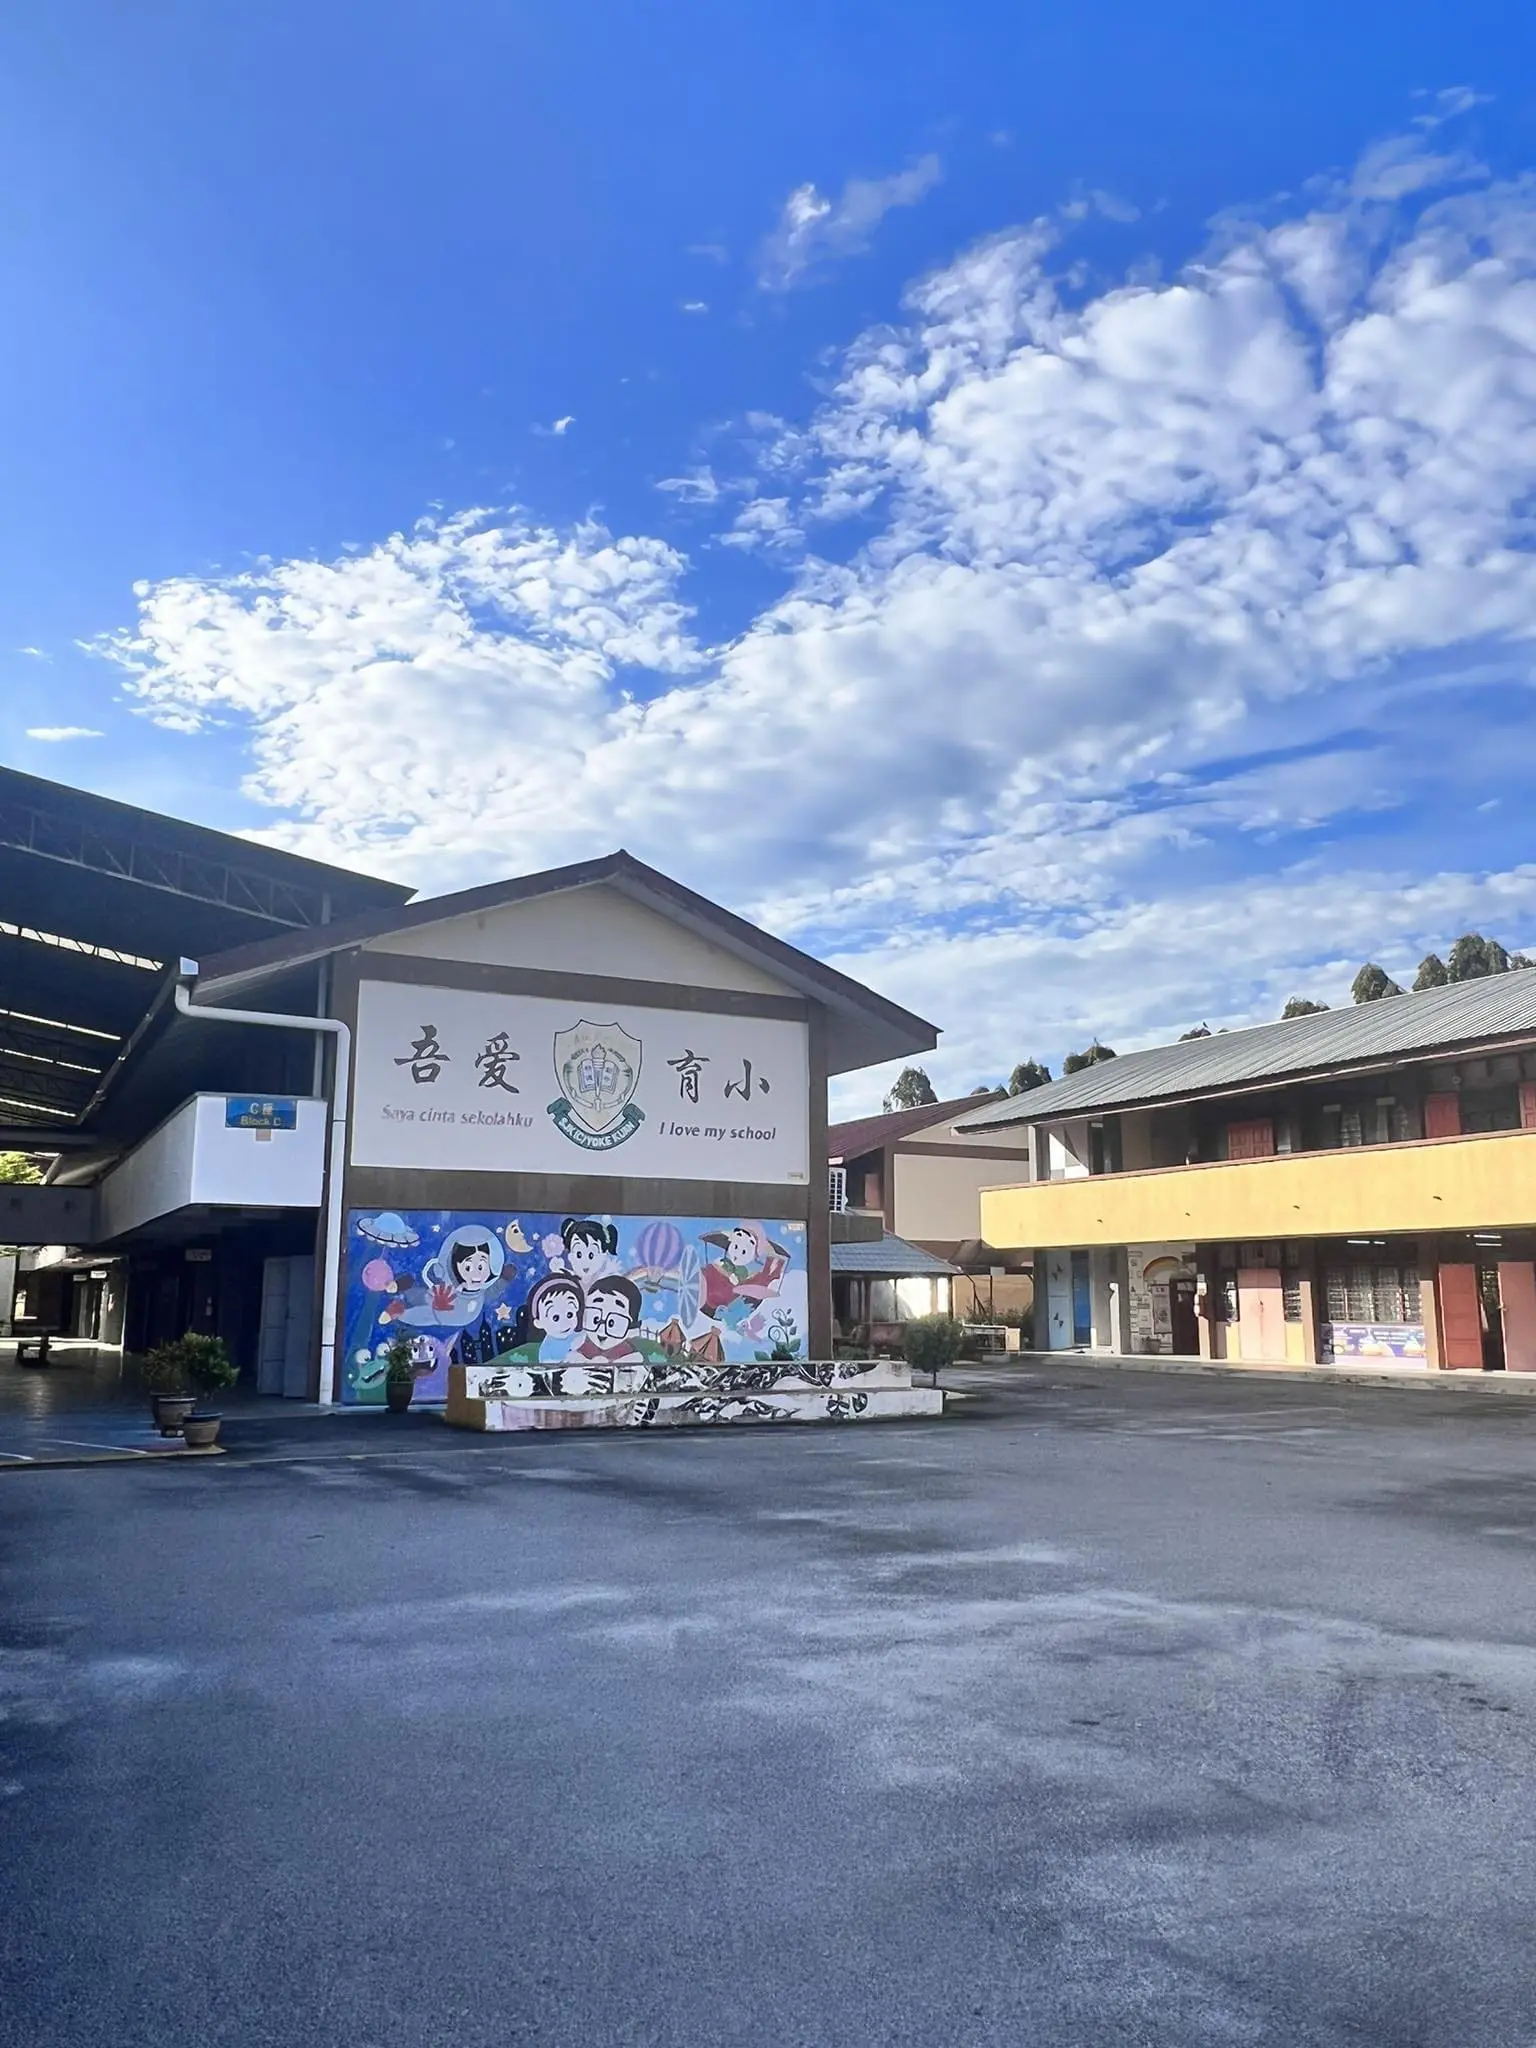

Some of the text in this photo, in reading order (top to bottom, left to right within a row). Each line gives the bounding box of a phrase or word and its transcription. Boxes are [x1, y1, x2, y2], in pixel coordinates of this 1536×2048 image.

[240, 1116, 269, 1125] Block
[381, 1104, 533, 1128] Saya cinta sekolahku
[659, 1122, 777, 1141] I love my school
[586, 1135, 612, 1147] YOKE
